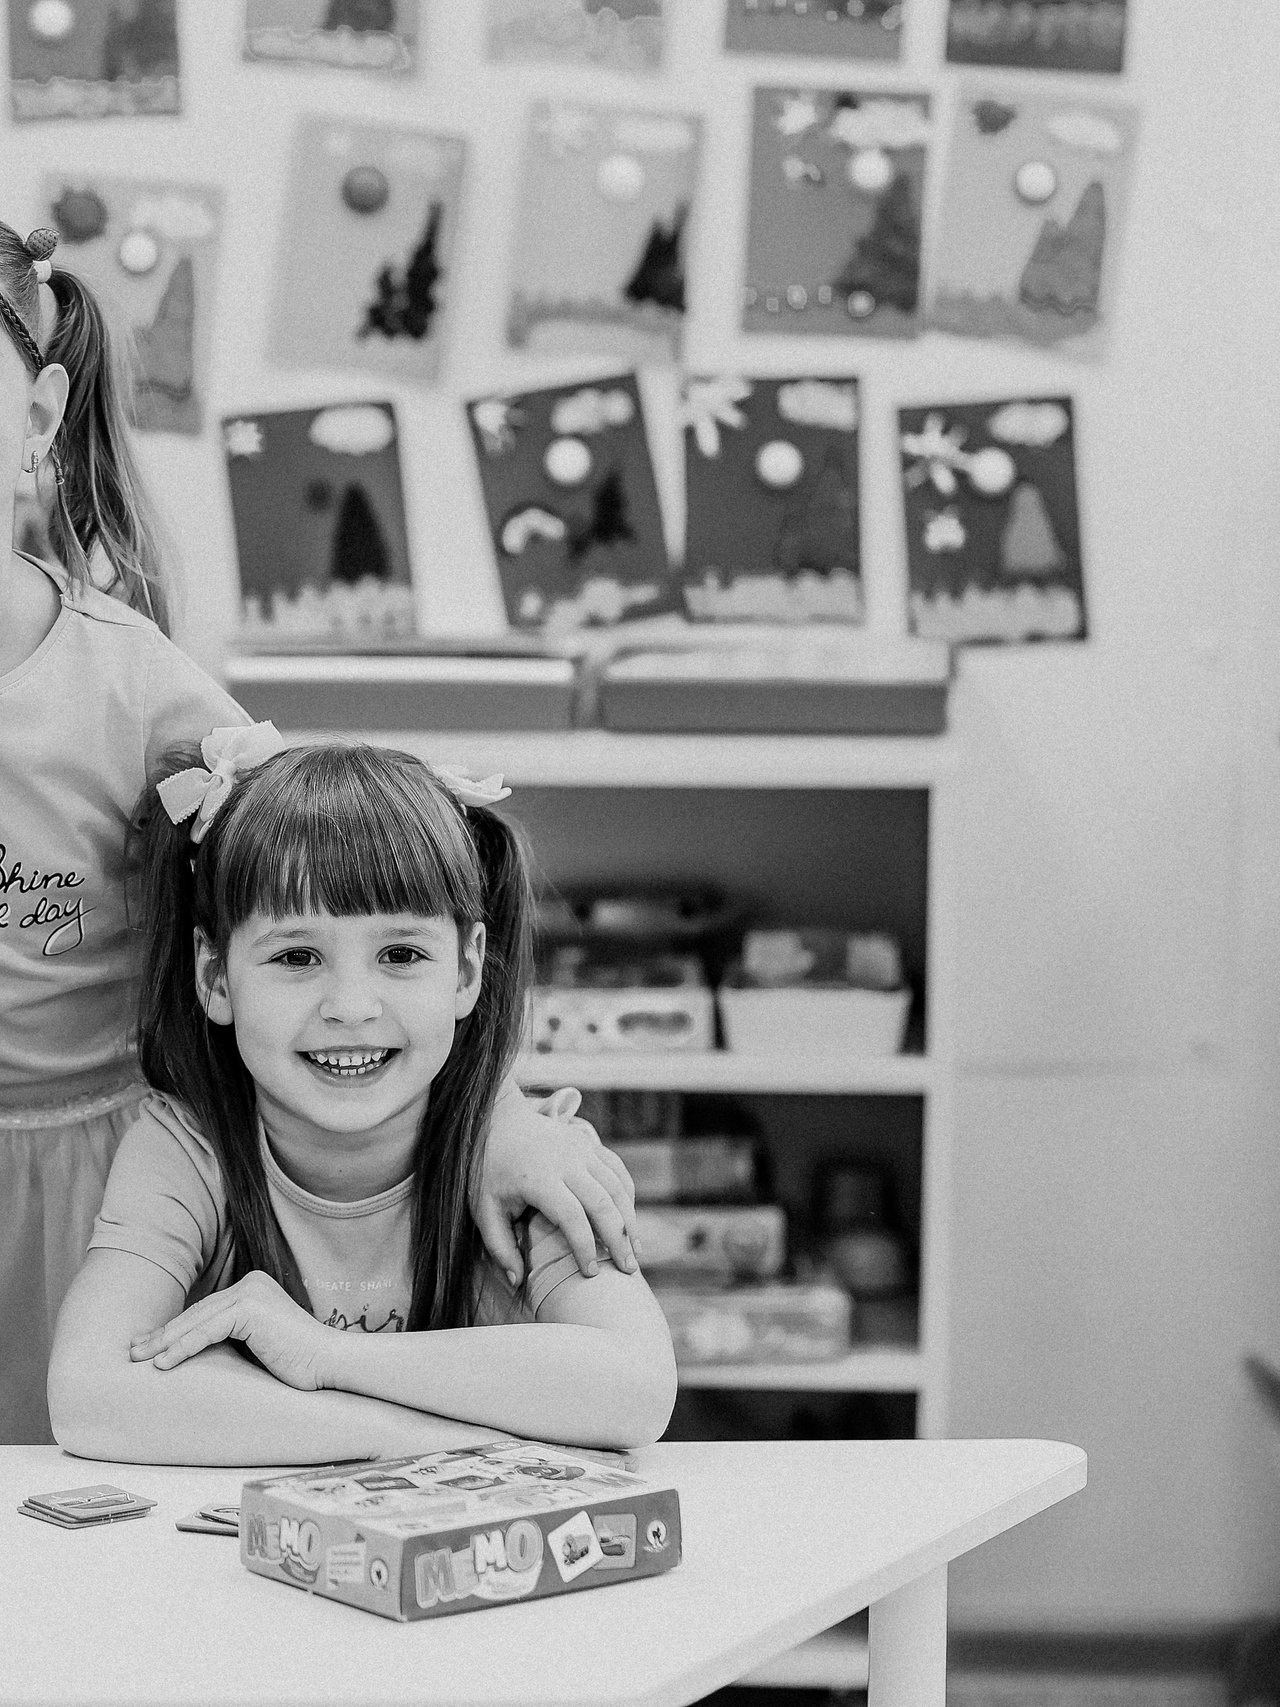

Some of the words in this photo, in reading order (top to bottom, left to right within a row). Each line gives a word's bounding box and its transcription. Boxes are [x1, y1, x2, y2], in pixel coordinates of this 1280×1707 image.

[20, 897, 96, 956] day
[246, 1513, 320, 1571] MEMO
[414, 1519, 544, 1608] MEMO
